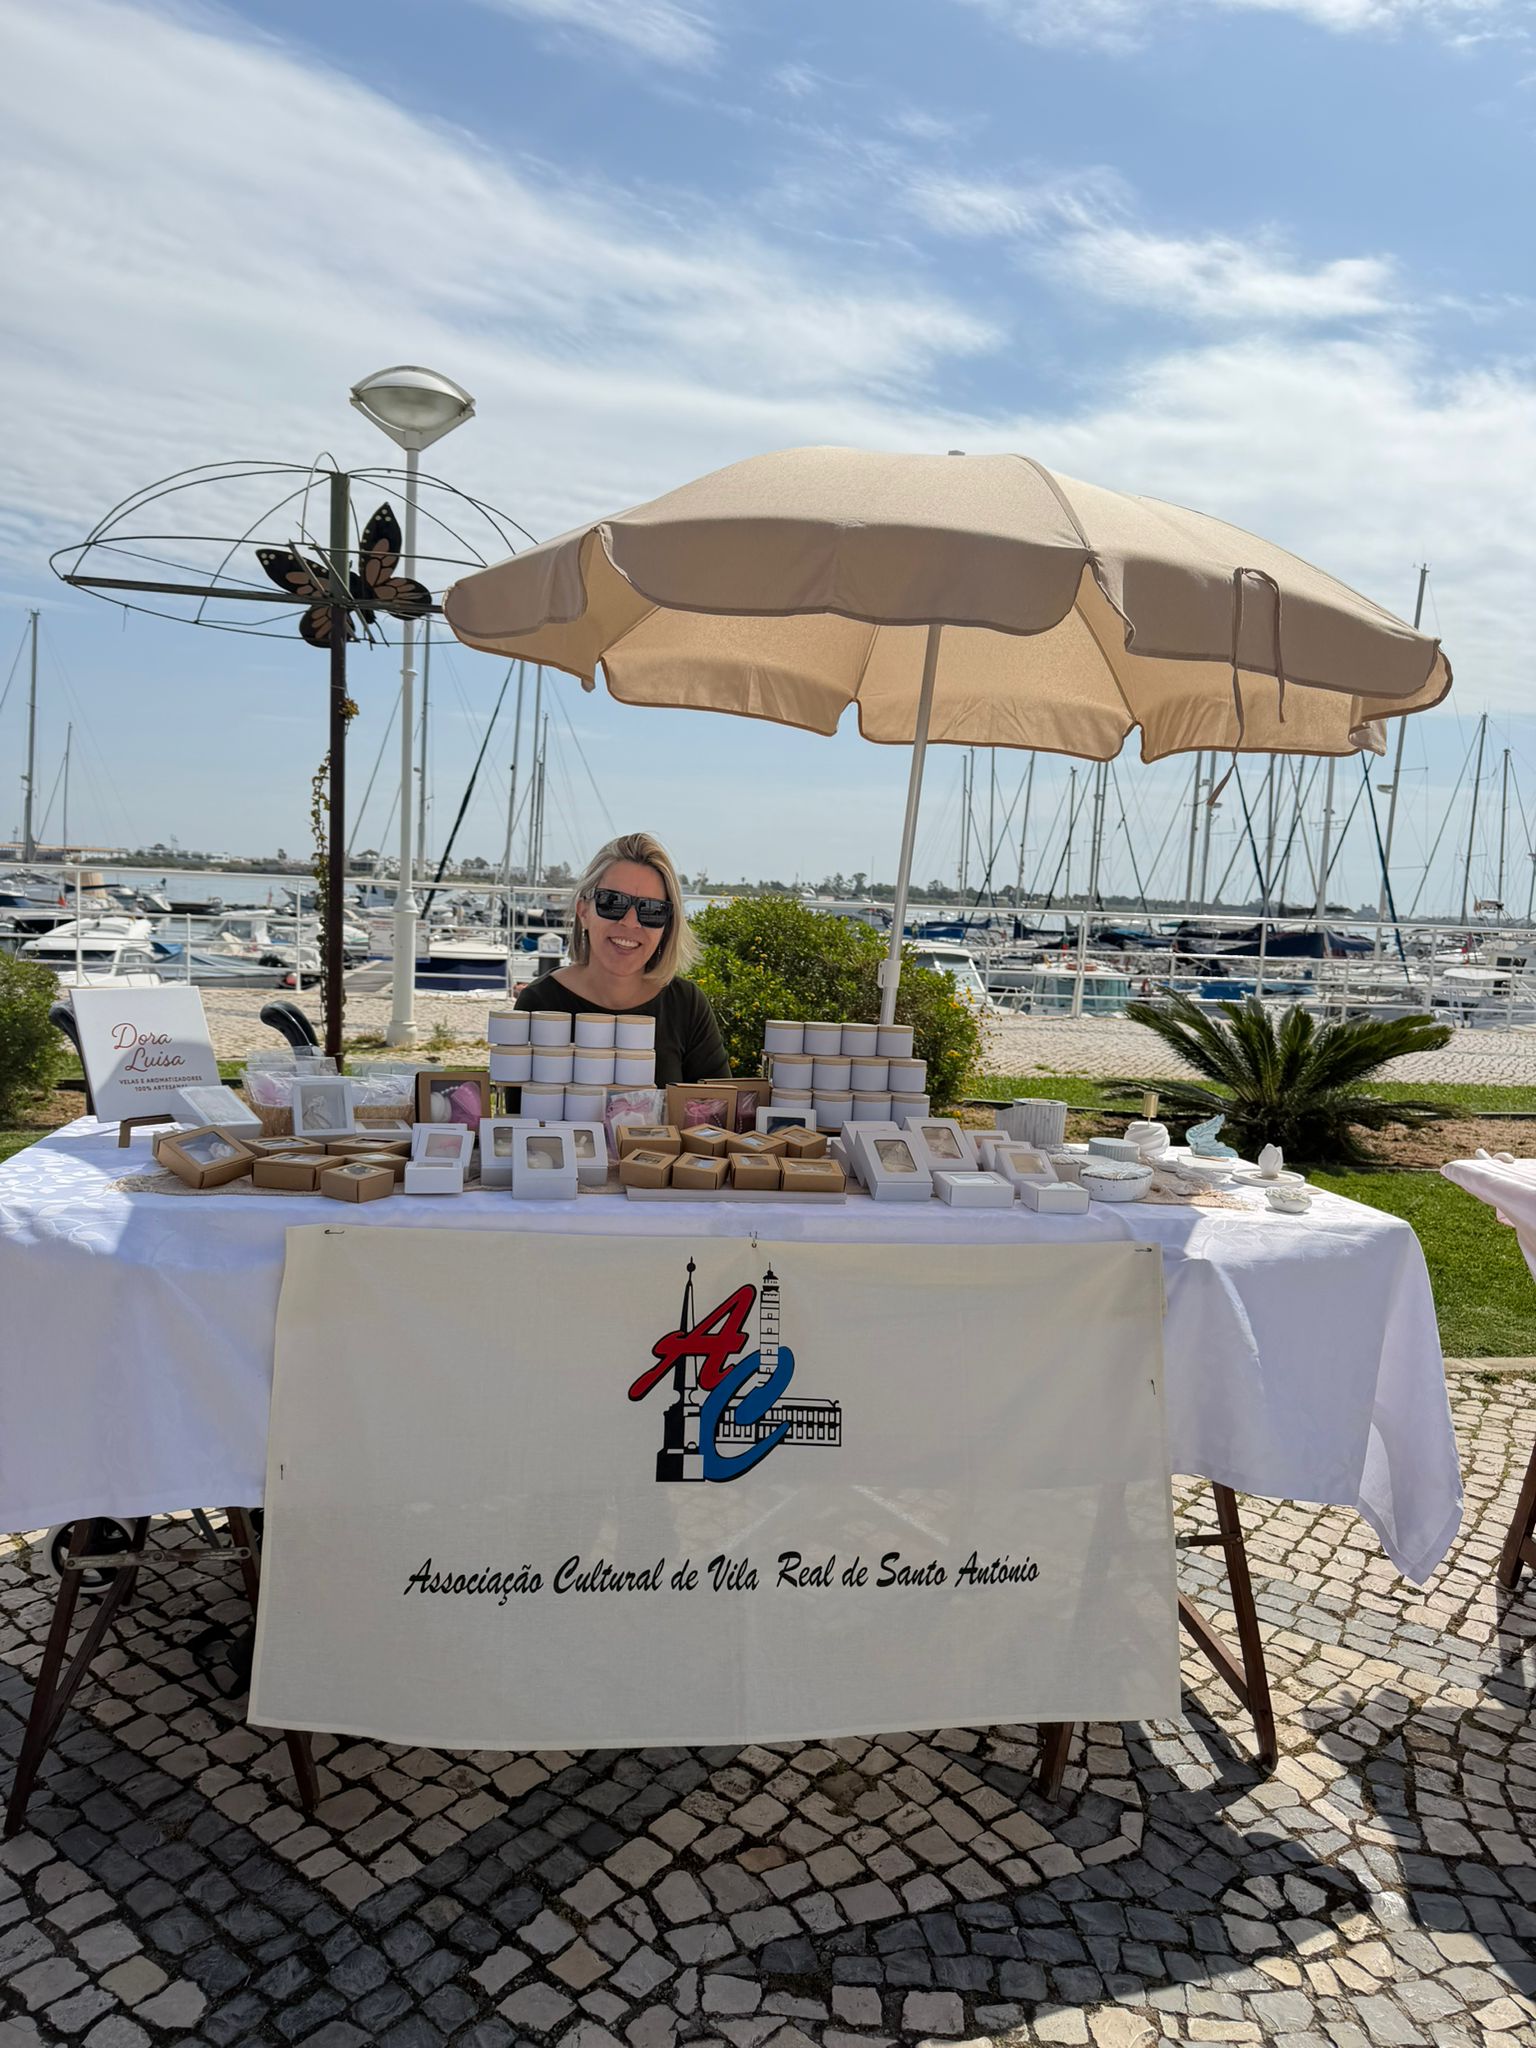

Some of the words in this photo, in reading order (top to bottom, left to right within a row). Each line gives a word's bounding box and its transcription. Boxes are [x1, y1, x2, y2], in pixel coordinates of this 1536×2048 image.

[111, 1022, 173, 1050] Dora
[124, 1047, 186, 1073] Luisa
[146, 1075, 203, 1083] AROMATIZADORES
[403, 1557, 545, 1607] Associação
[553, 1555, 665, 1594] Cultural
[670, 1558, 699, 1592] de
[707, 1554, 760, 1593] Vila
[776, 1550, 836, 1588] Real
[841, 1556, 869, 1588] de
[875, 1551, 948, 1588] Santo
[954, 1550, 1040, 1588] António
